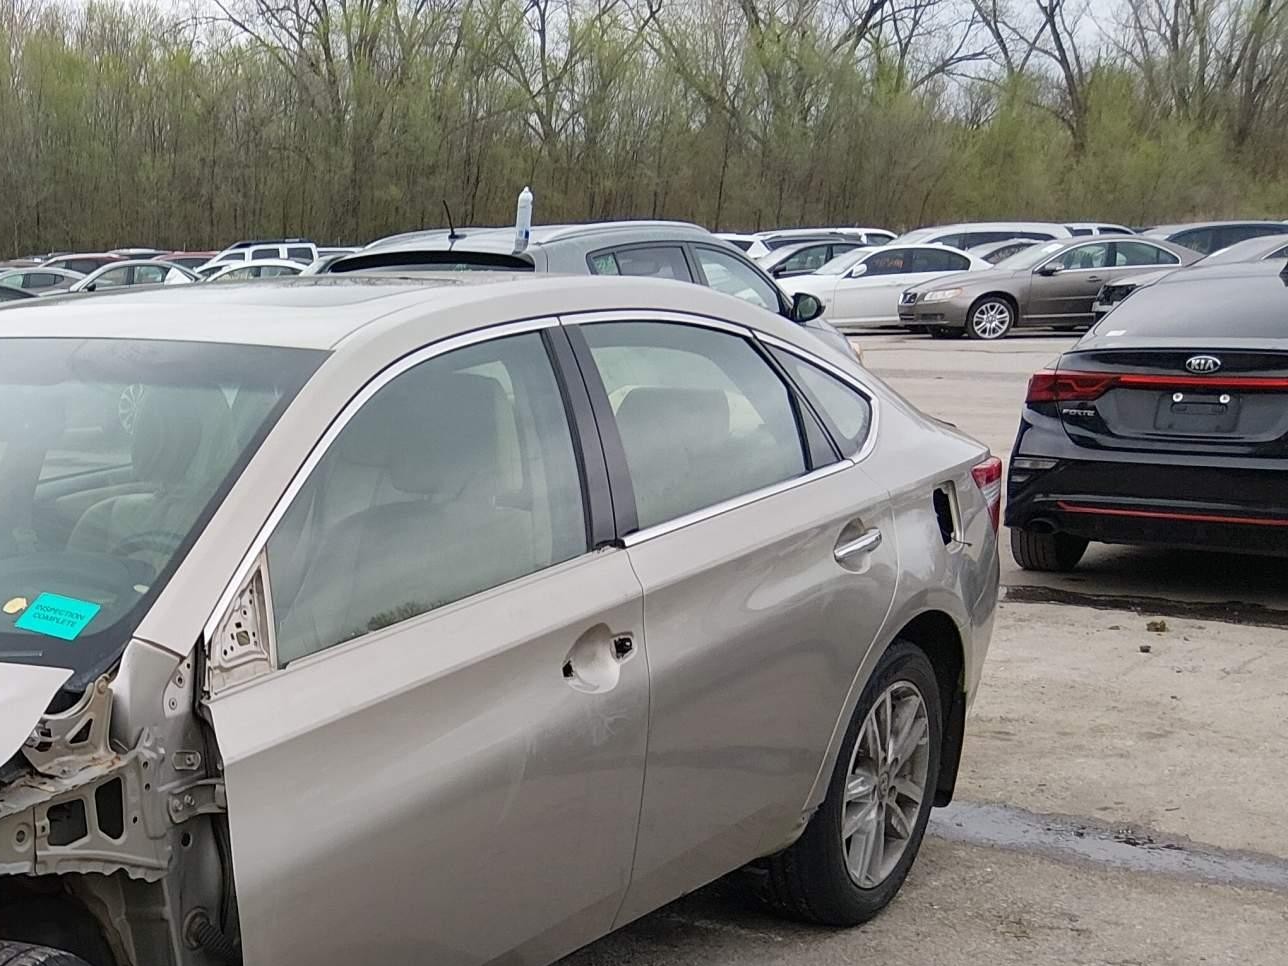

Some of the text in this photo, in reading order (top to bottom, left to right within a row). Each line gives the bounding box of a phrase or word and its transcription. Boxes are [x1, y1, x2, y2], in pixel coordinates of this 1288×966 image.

[1189, 357, 1216, 371] KIA
[1062, 408, 1096, 417] FORTE
[33, 612, 78, 628] COMPLETE
[35, 604, 86, 621] INSPECTION
